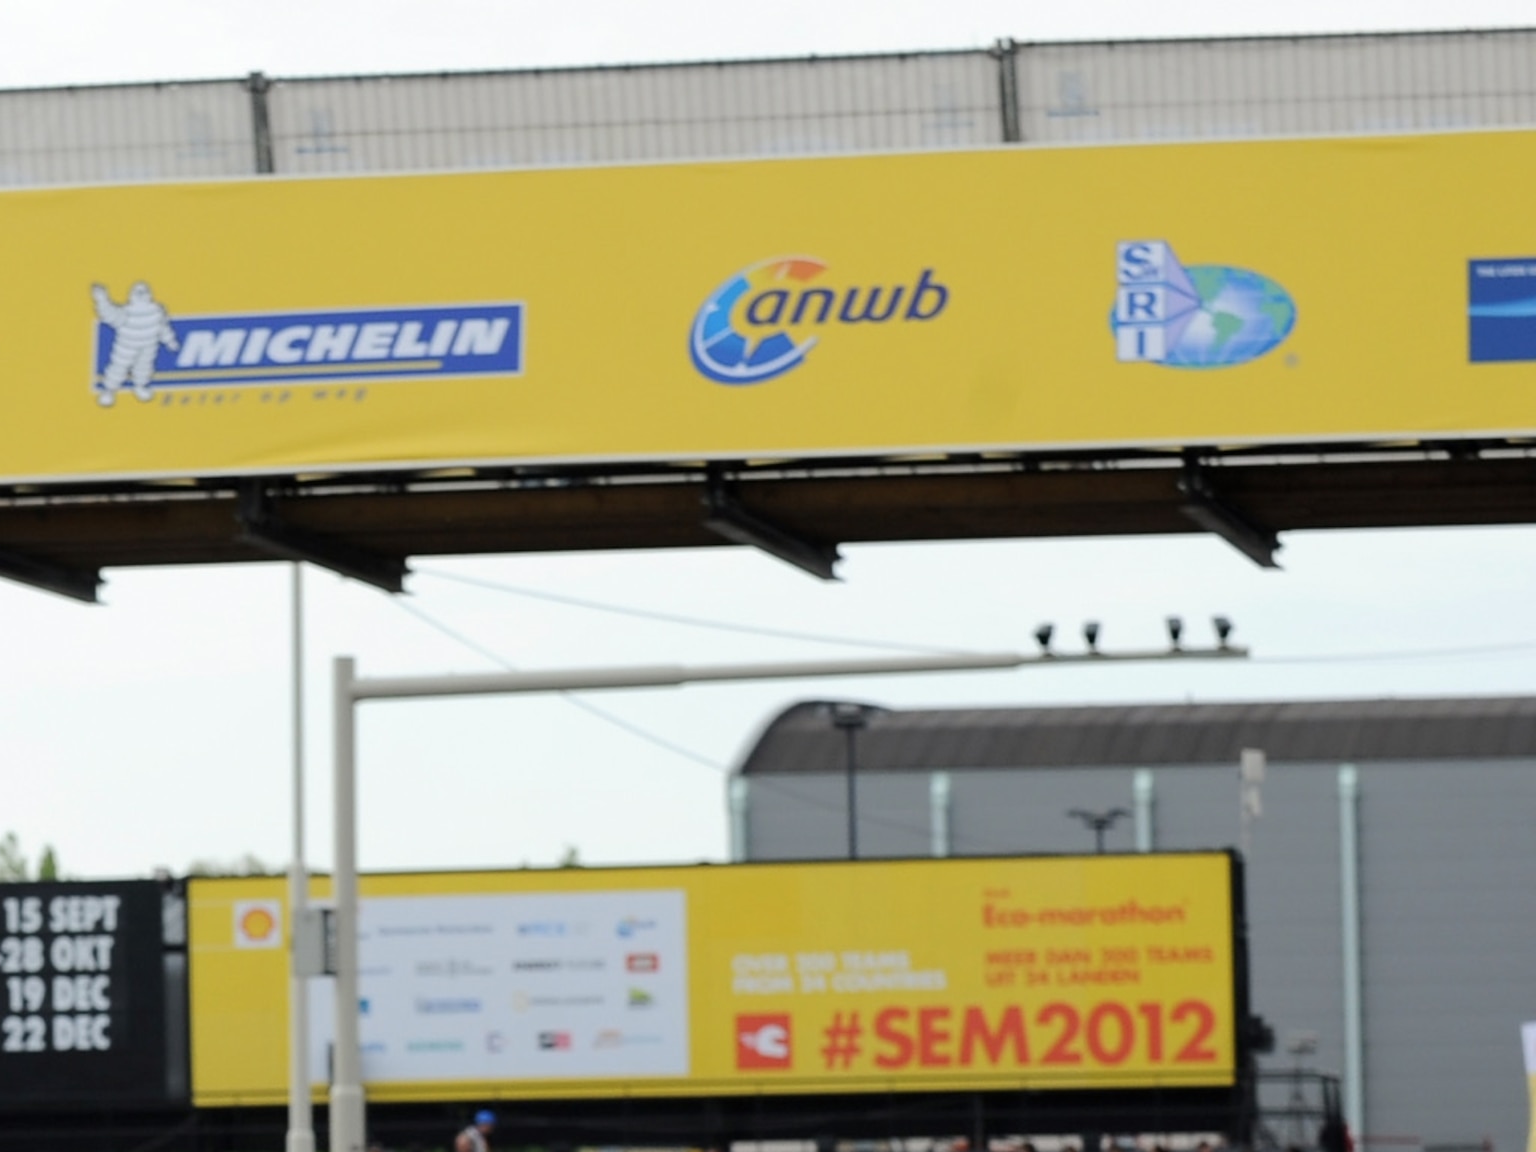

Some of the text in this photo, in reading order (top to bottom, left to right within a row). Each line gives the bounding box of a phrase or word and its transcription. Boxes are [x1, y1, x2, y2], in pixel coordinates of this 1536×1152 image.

[745, 268, 951, 327] anwb
[175, 318, 510, 368] MICHELIN
[3, 896, 43, 934] 15
[49, 894, 120, 932] SEPT
[50, 934, 114, 972] OKT
[8, 976, 45, 1012] 19
[52, 974, 111, 1011] DEC
[2, 1013, 111, 1051] 22 DEC
[822, 1000, 1216, 1069] #SEM2012
